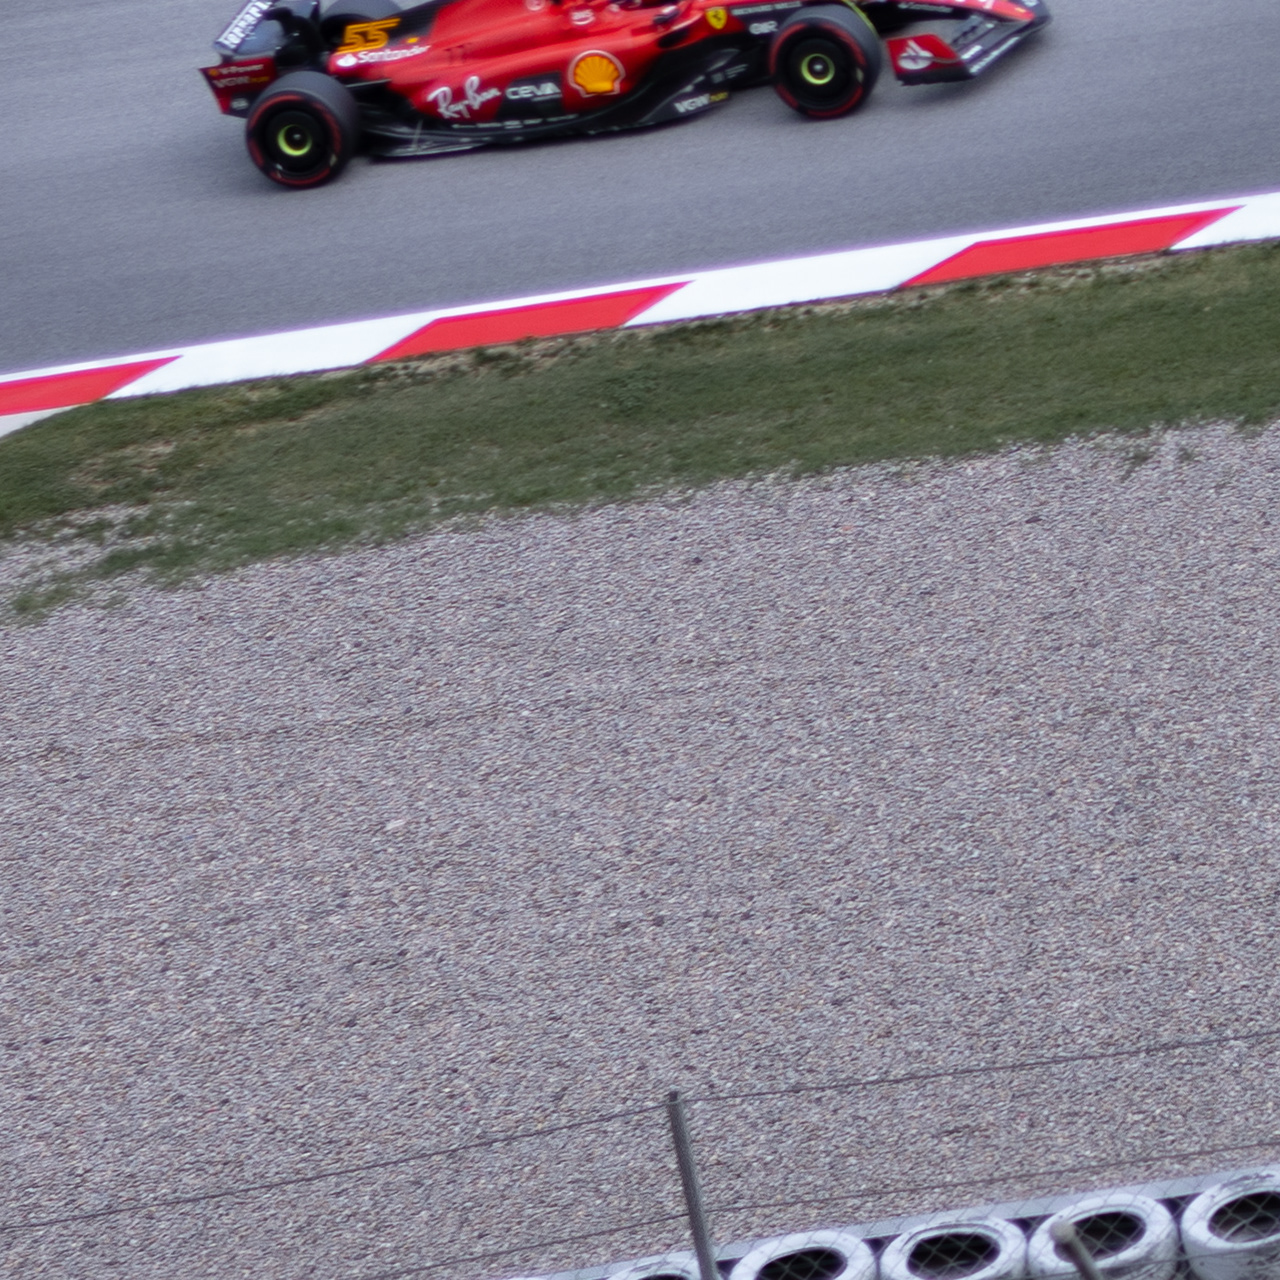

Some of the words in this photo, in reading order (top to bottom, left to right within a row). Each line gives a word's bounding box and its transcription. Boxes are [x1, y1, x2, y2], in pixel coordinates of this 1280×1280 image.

[335, 18, 401, 55] 55
[357, 45, 431, 64] Santander
[505, 81, 561, 101] CEVA
